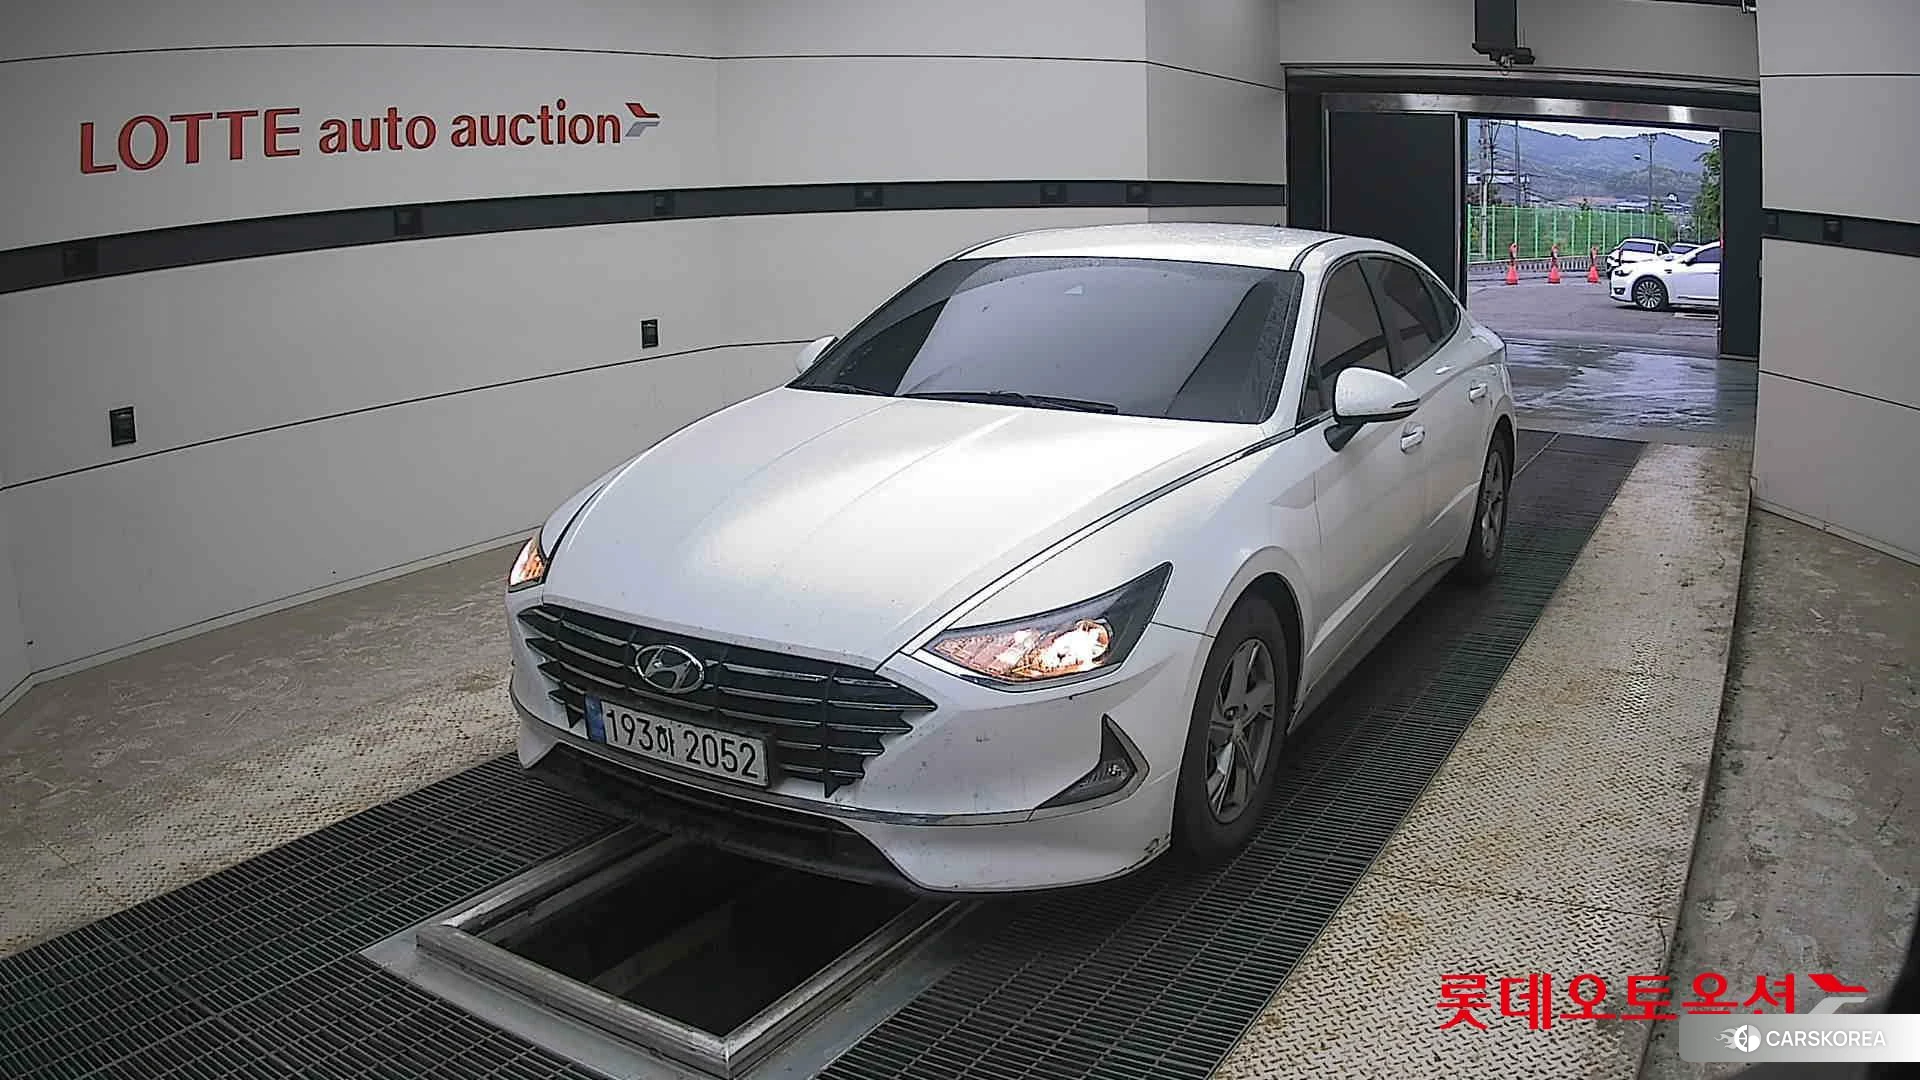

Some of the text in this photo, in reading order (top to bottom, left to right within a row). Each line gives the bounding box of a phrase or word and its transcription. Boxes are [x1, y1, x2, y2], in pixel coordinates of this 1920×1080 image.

[80, 98, 623, 175] LOTTE auto auction
[606, 709, 758, 778] 193하 2052
